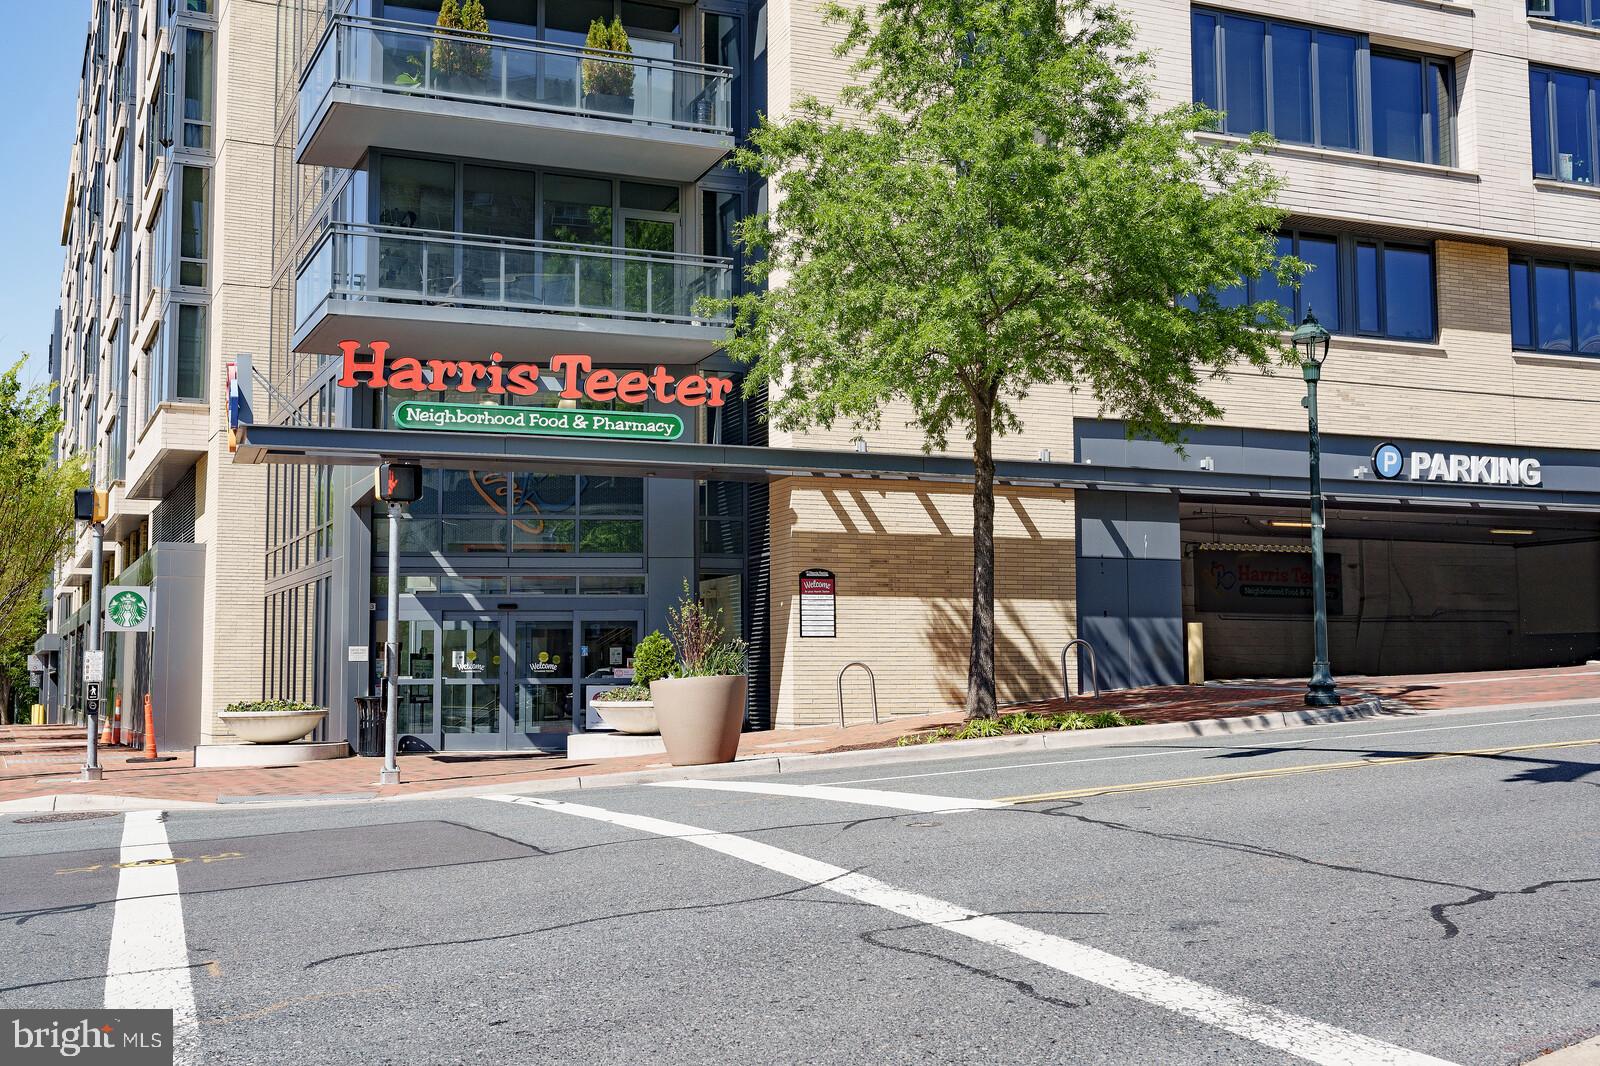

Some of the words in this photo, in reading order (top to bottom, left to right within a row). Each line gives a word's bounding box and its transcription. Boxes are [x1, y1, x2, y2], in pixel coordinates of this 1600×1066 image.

[337, 340, 539, 396] Harris
[551, 354, 733, 407] Teeter
[406, 408, 526, 426] Neighborhood
[530, 414, 569, 429] Food
[573, 415, 589, 429] &
[593, 416, 676, 436] Pharmacy
[1383, 452, 1398, 473] P
[1411, 451, 1541, 487] PARKING
[1238, 564, 1288, 583] Harris
[803, 580, 831, 590] Welcome
[456, 662, 485, 671] Welcome
[529, 662, 558, 671] Welcome
